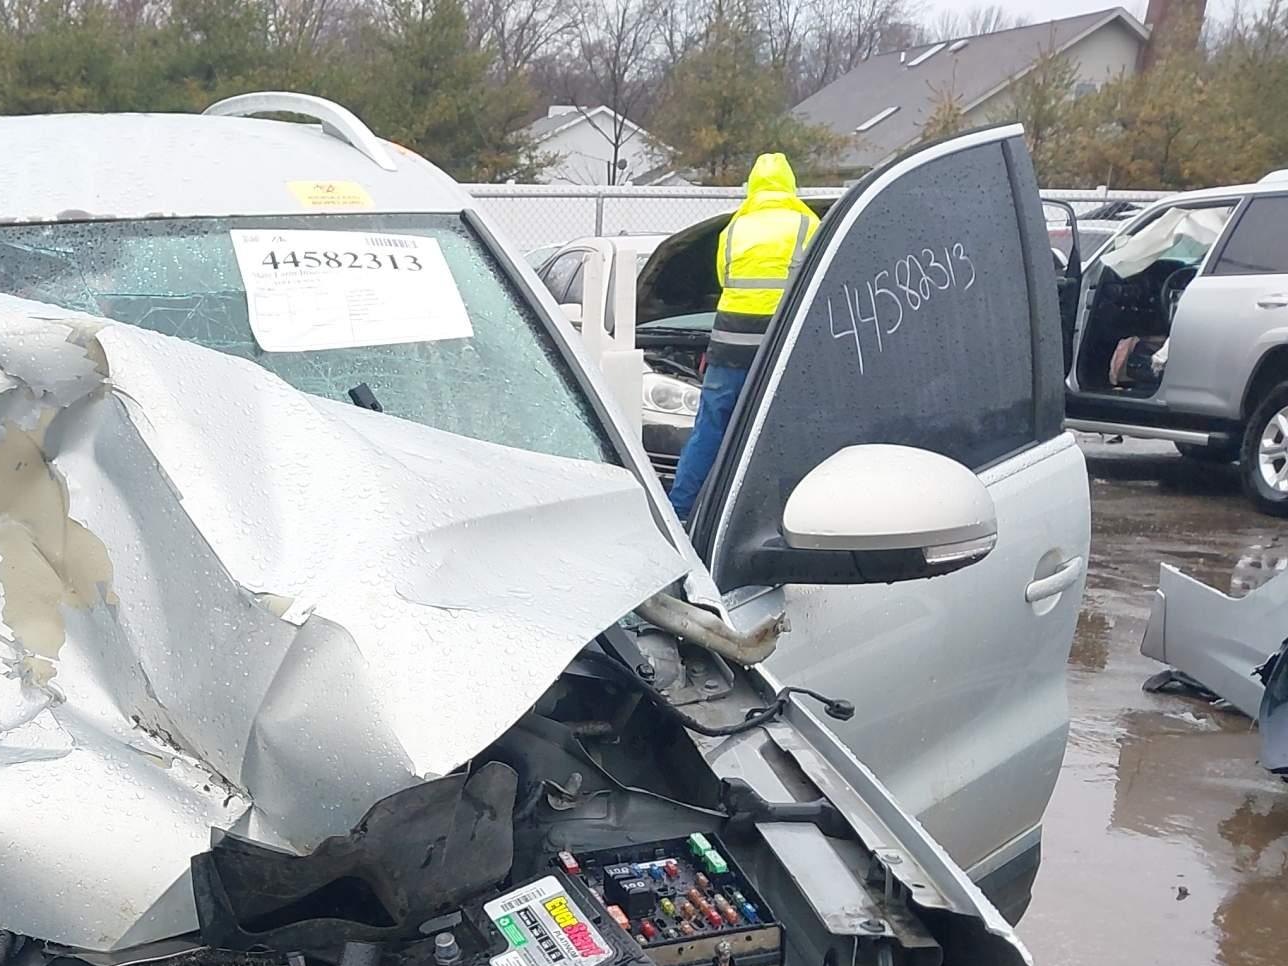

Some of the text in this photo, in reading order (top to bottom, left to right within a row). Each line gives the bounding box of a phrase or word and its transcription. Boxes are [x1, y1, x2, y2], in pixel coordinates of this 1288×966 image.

[261, 249, 423, 272] 44582313
[827, 242, 976, 375] 44582313
[543, 895, 606, 958] EverStart
[552, 930, 579, 959] PLATINUM
